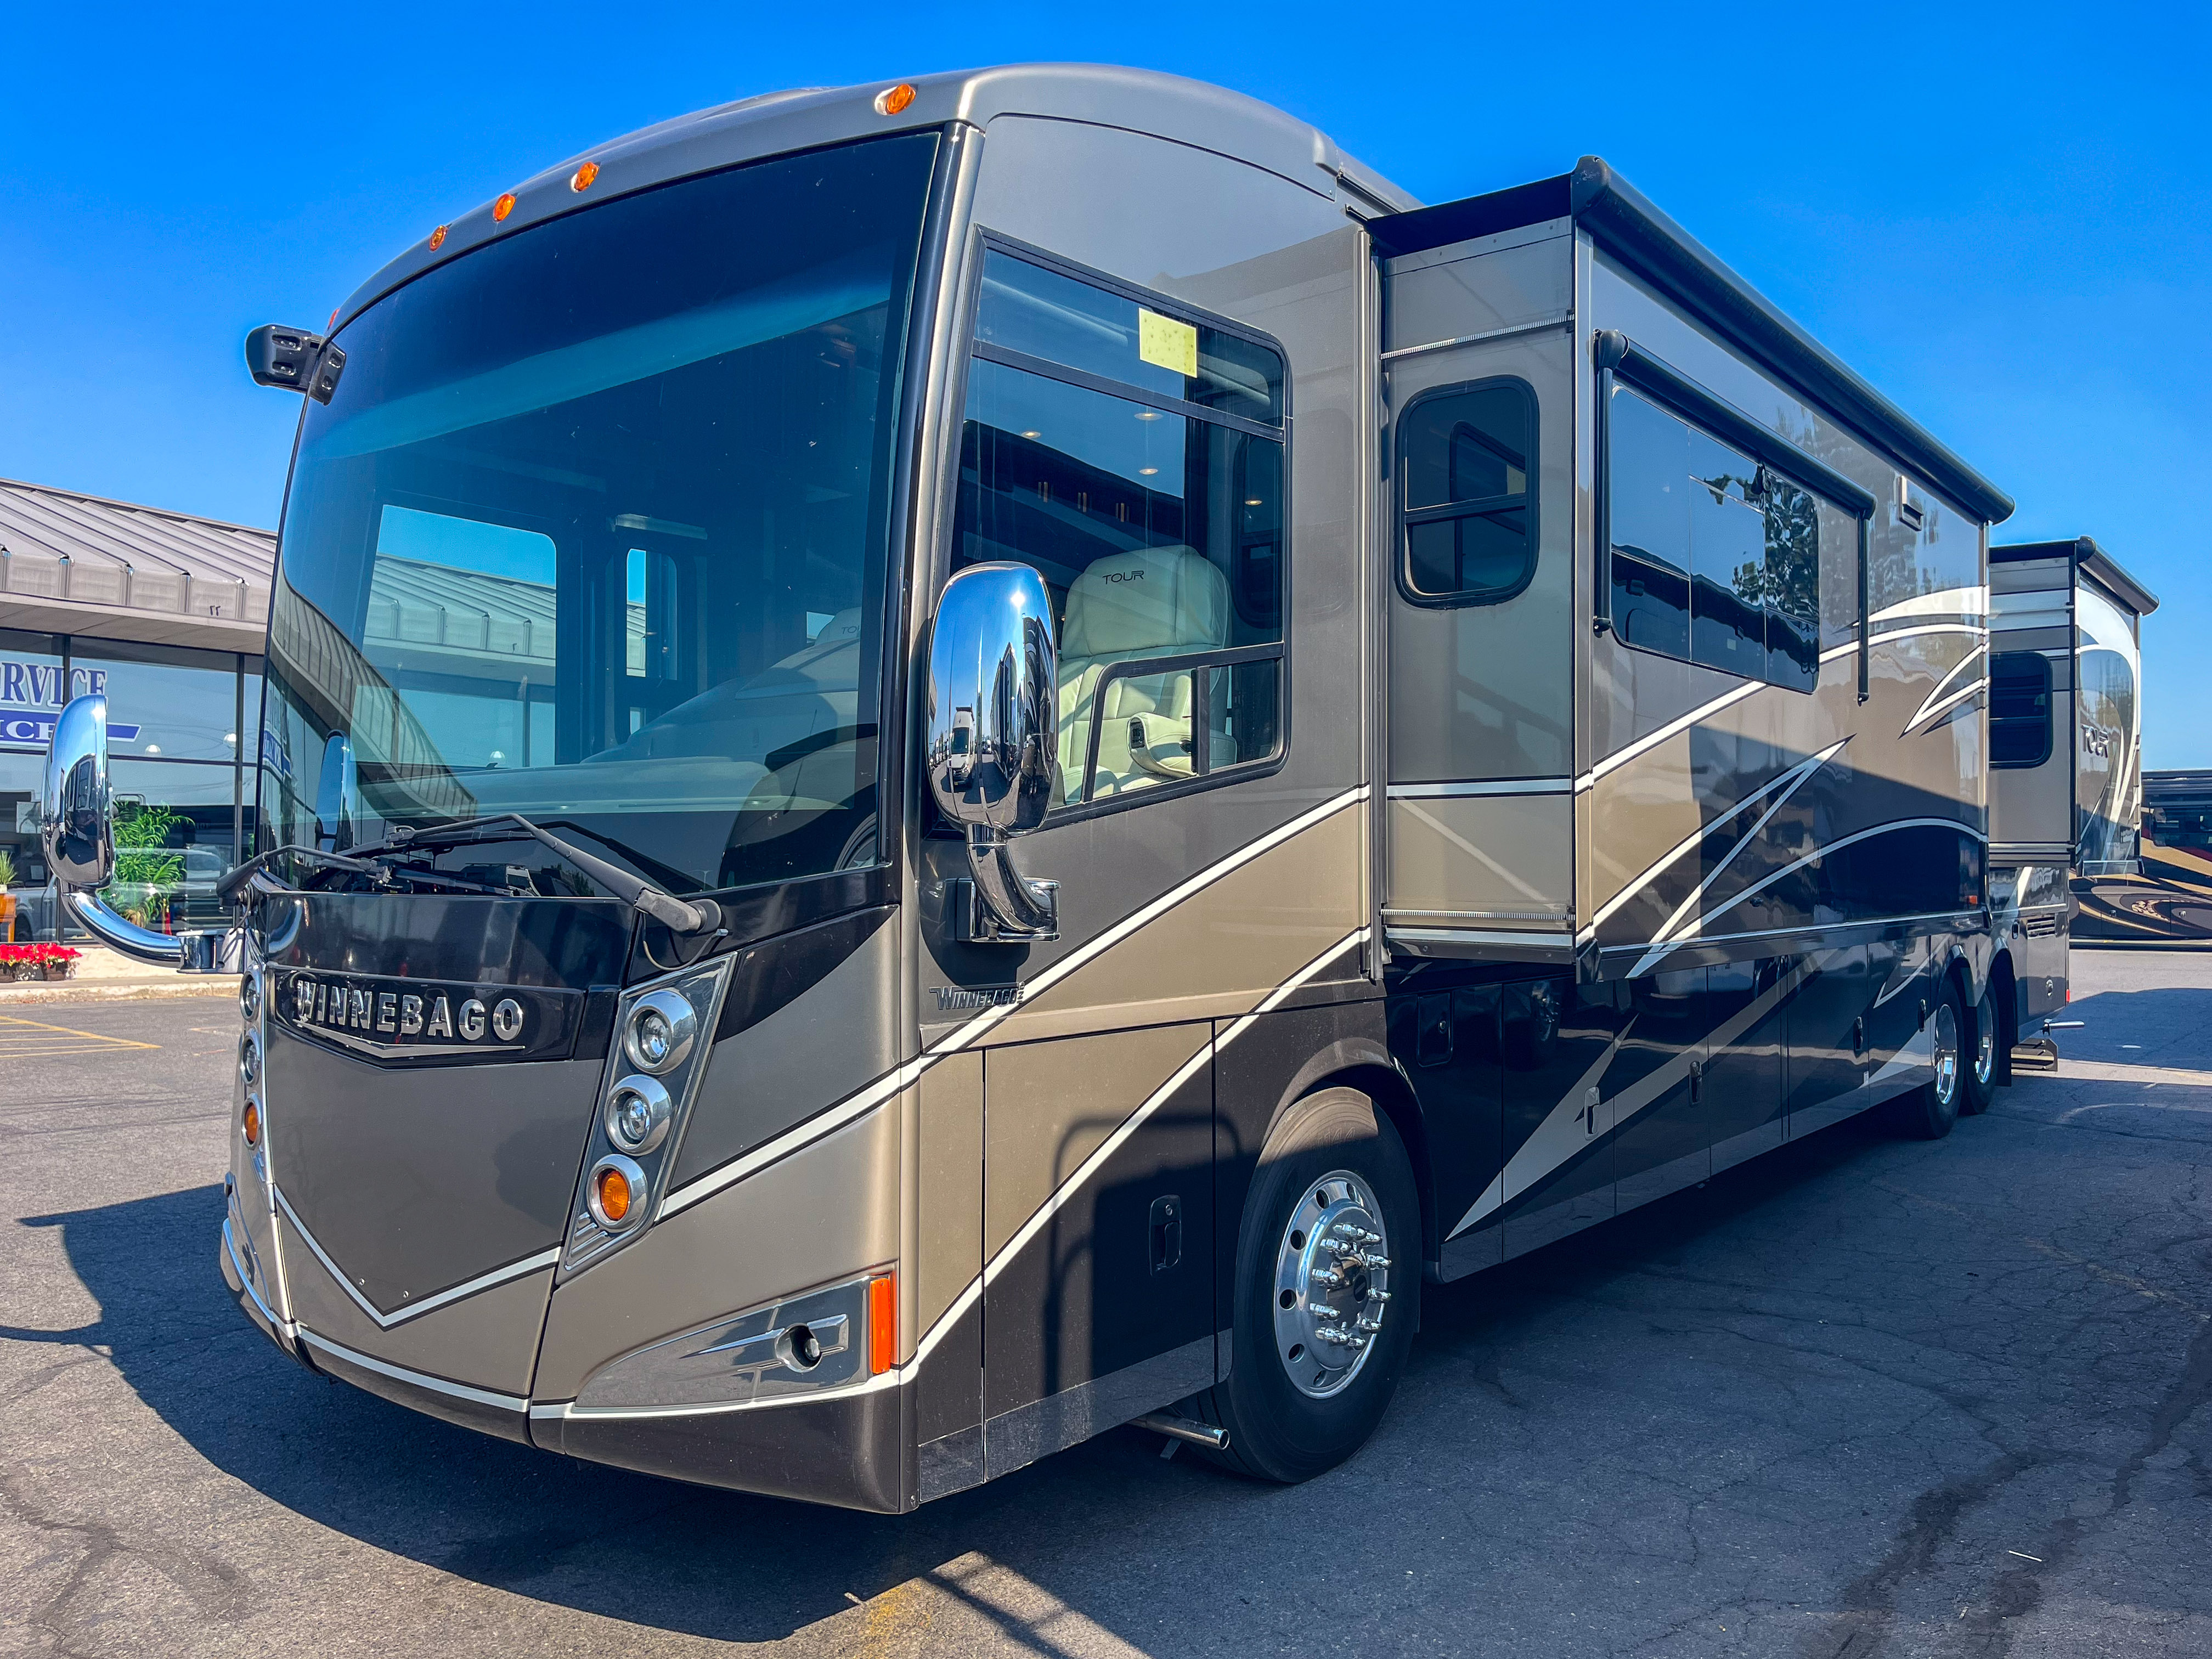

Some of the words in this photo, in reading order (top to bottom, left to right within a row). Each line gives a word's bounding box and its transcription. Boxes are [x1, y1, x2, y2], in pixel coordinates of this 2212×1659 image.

[1102, 570, 1144, 585] TOUR
[2081, 724, 2109, 758] TOUR
[297, 979, 524, 1041] WINNEBAGO
